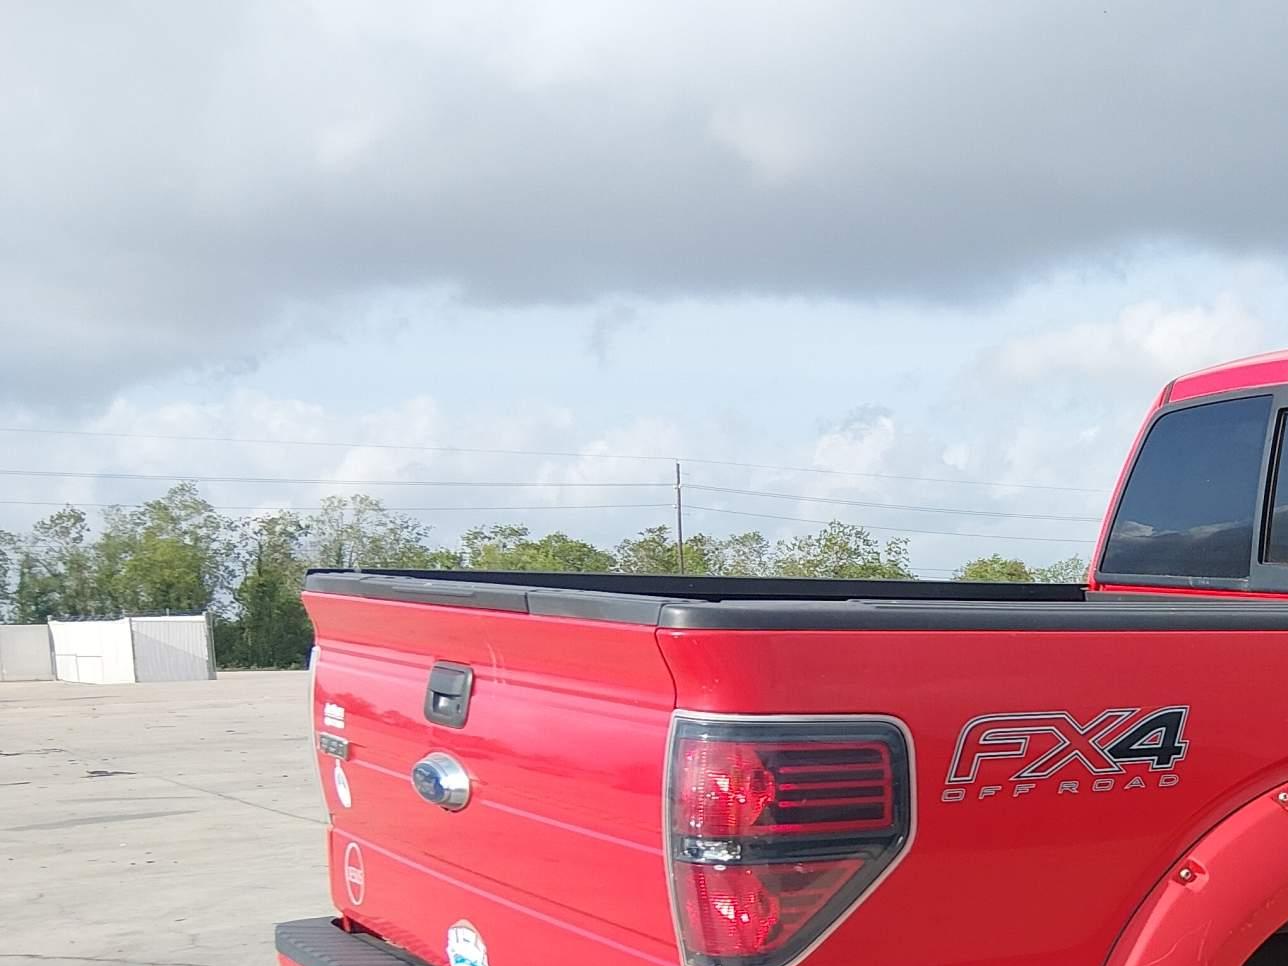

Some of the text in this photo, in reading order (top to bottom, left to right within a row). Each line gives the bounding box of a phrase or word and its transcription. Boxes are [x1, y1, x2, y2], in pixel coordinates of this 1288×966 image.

[945, 705, 1190, 784] FX4
[942, 774, 1180, 802] OFF ROAD
